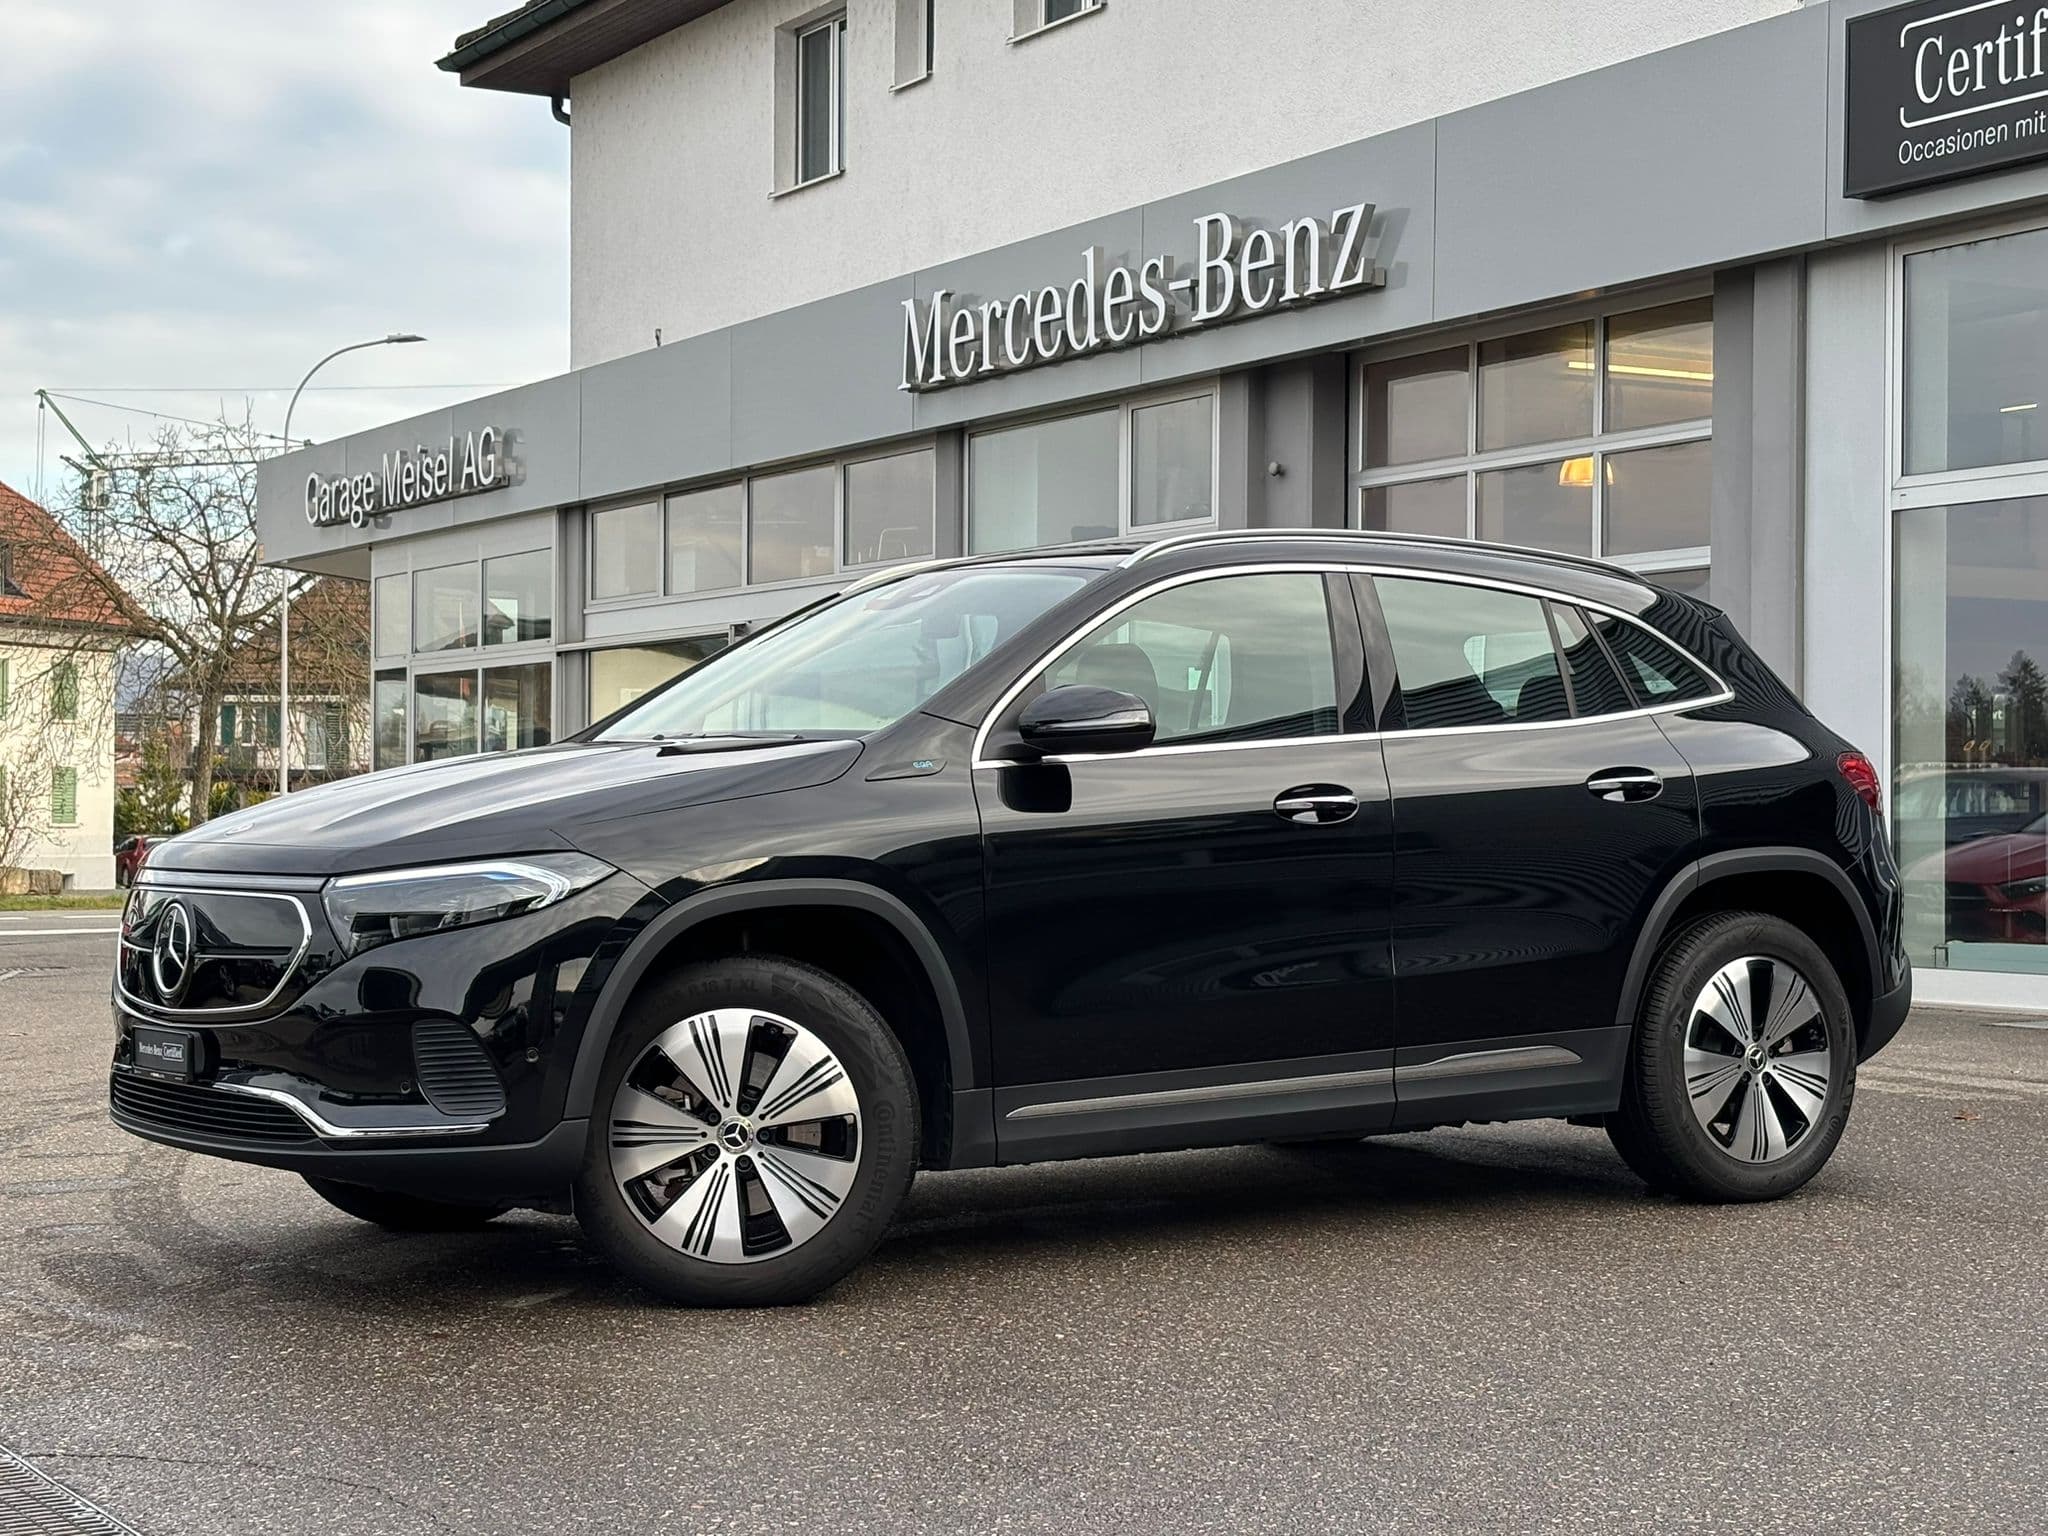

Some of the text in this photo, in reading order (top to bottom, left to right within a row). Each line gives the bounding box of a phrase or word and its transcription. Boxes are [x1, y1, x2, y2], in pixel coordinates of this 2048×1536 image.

[1914, 7, 2048, 104] Certif
[1898, 110, 2047, 165] Occasionen mit
[897, 202, 1378, 391] Mercedes-Benz
[305, 425, 498, 529] Garage Meisel AG
